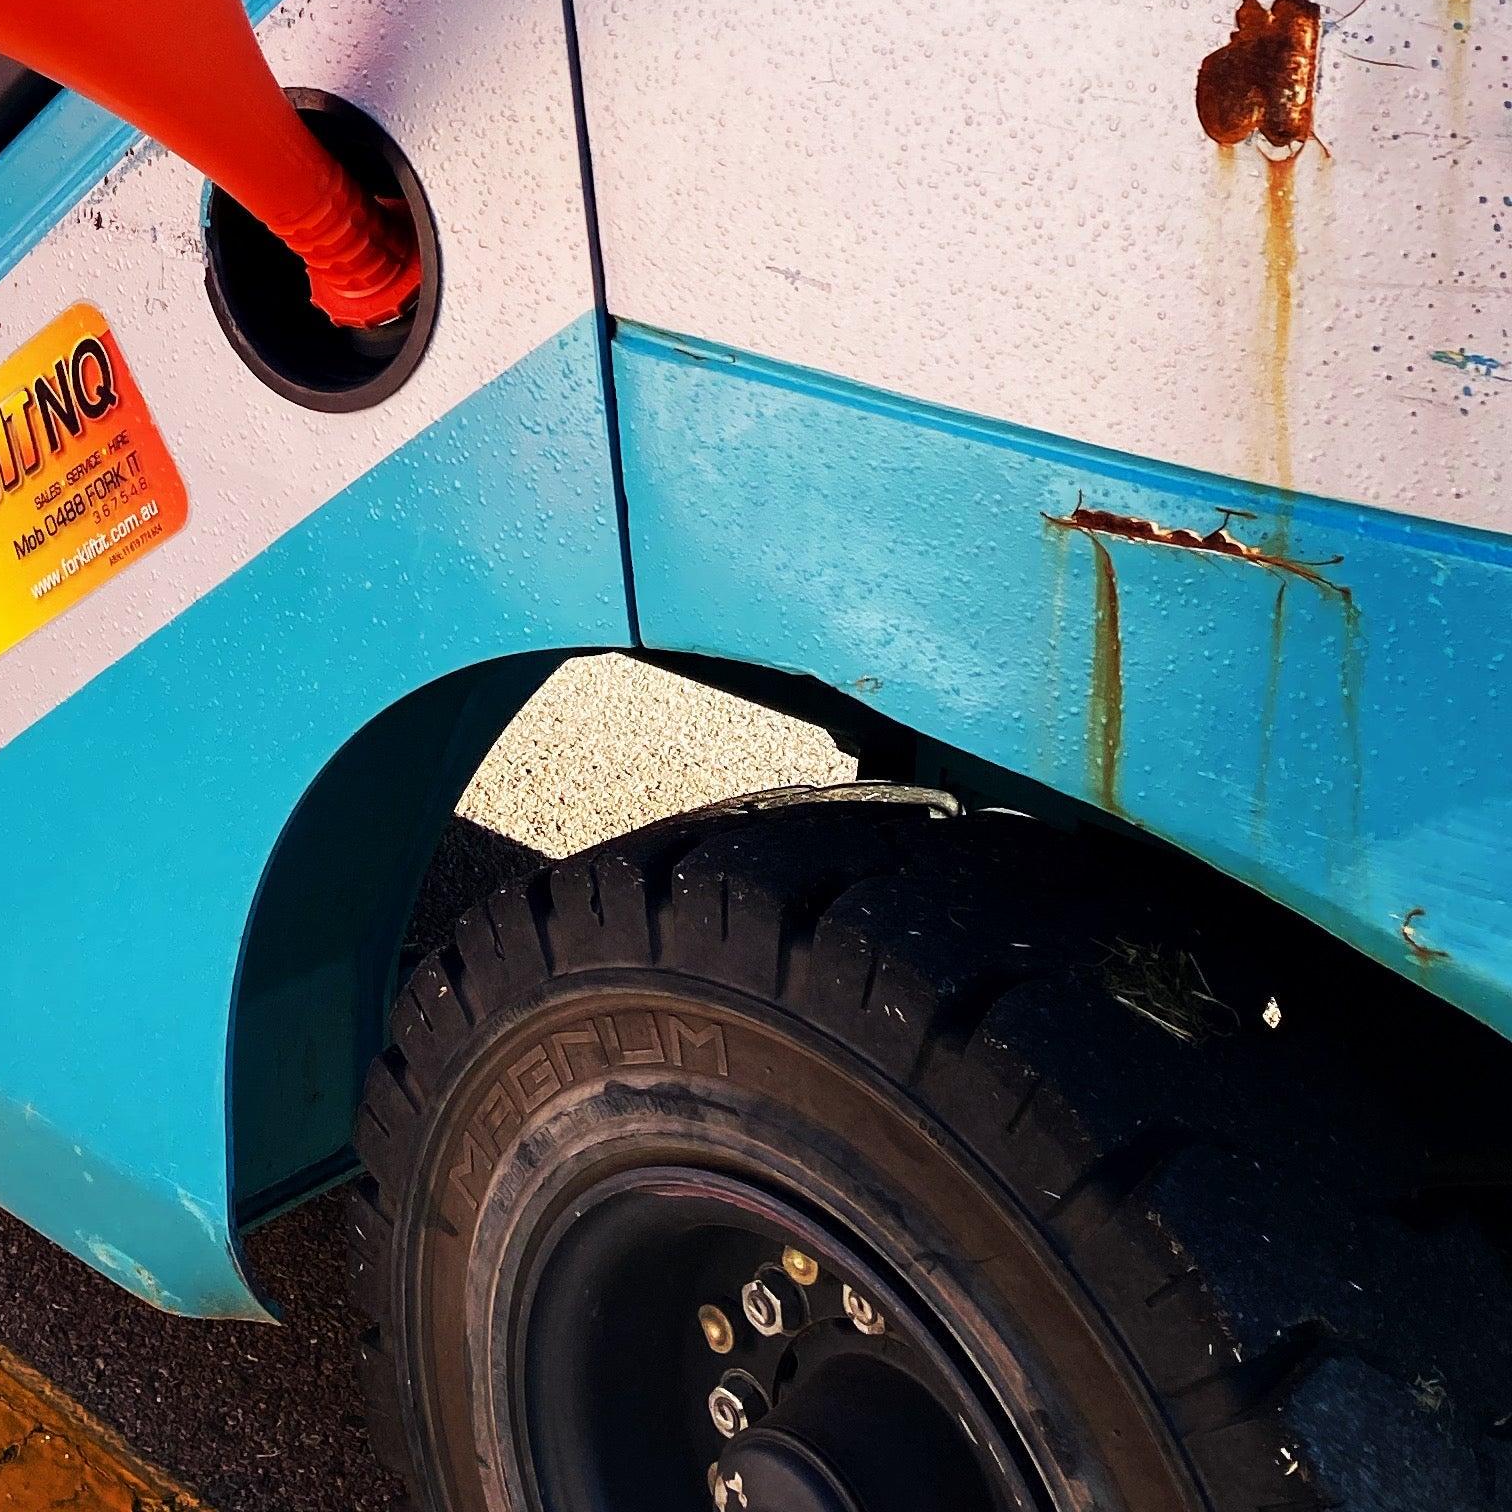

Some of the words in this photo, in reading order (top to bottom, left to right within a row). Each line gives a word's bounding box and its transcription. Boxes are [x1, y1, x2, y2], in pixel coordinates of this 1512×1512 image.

[13, 526, 45, 560] Mob
[44, 493, 86, 537] 0488
[85, 465, 127, 506] FORK
[126, 450, 141, 476] IT
[34, 481, 62, 510] SALES
[65, 449, 102, 486] SERVICE
[107, 429, 130, 454] HIRE
[30, 499, 159, 598] www.forkliftit.com.au
[448, 1011, 729, 1211] MAGNUM
